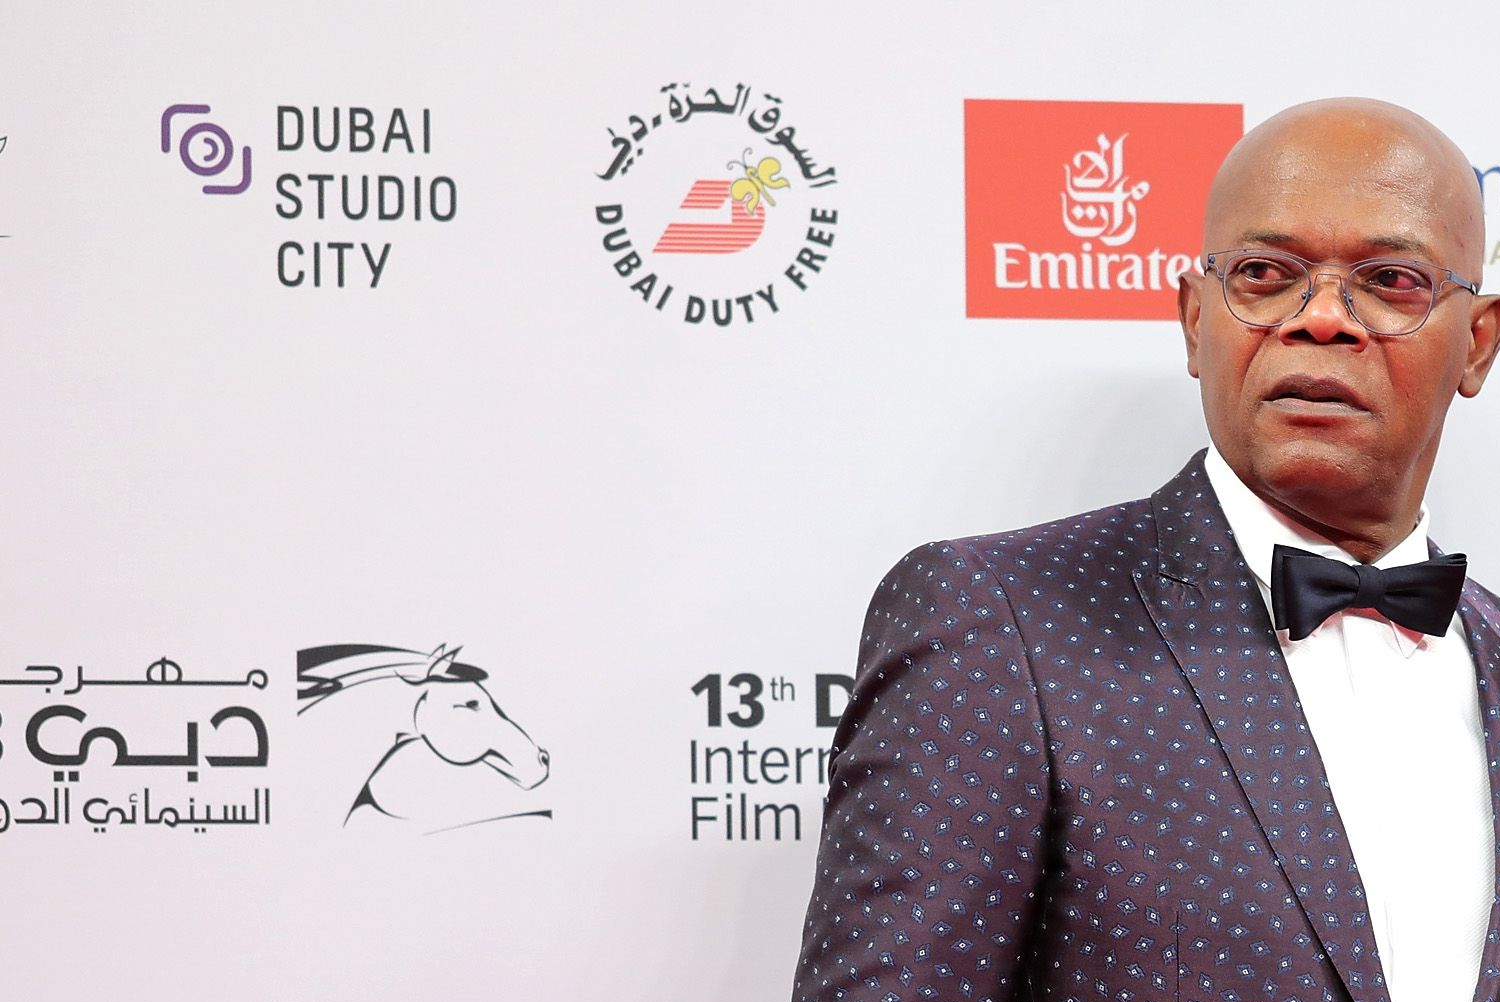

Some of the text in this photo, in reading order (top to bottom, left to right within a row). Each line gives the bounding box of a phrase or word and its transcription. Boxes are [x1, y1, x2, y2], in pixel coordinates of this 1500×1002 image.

[277, 106, 430, 154] DUBAI
[276, 173, 456, 222] STUDIO
[278, 241, 391, 288] CITY
[595, 204, 838, 328] DUBAI DUTY FREE
[691, 673, 795, 728] 13th
[26, 705, 269, 782] دبي
[83, 788, 270, 833] السينمائي
[692, 793, 801, 841] Film
